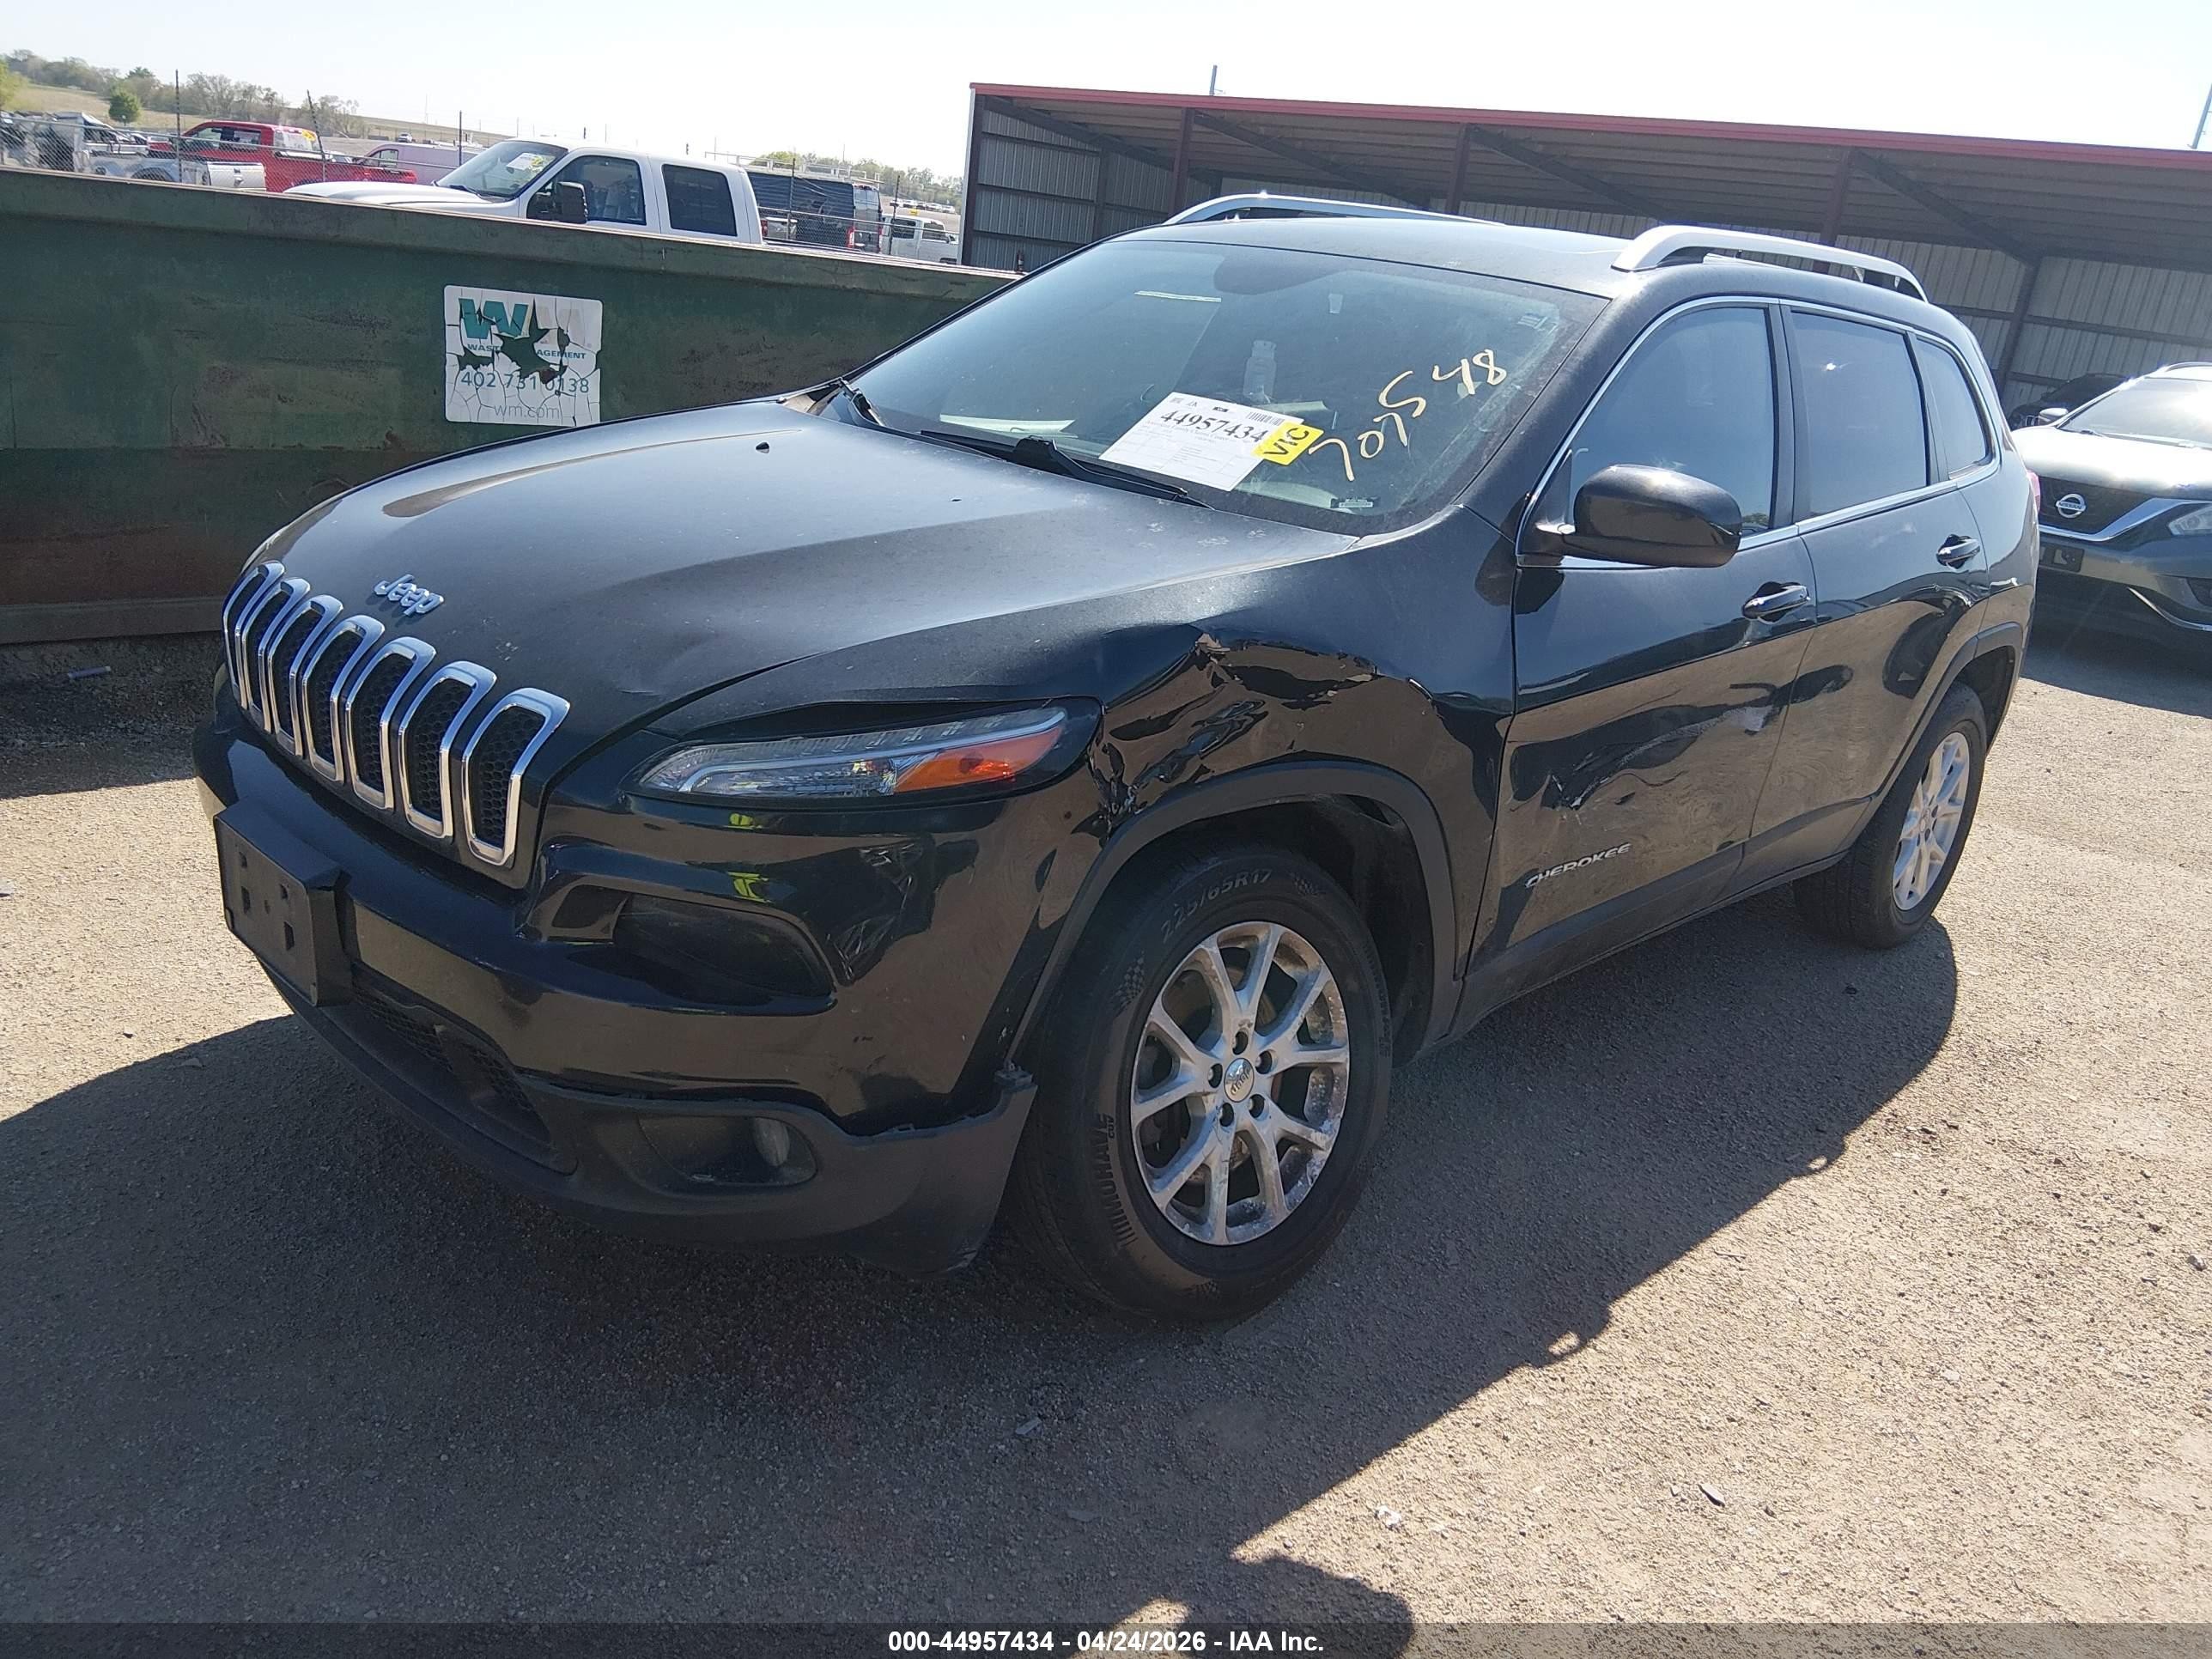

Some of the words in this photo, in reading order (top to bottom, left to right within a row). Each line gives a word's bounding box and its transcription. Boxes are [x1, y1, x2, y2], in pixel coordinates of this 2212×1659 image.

[467, 343, 501, 352] WAST
[537, 349, 586, 359] AGEMENT
[461, 371, 496, 388] 402
[494, 404, 558, 419] wm.com
[1160, 410, 1268, 442] 44957434
[1264, 428, 1310, 456] VIC
[374, 574, 444, 616] Jeep
[1524, 842, 1632, 889] CHEROKEE
[1160, 868, 1273, 945] 225/65R17
